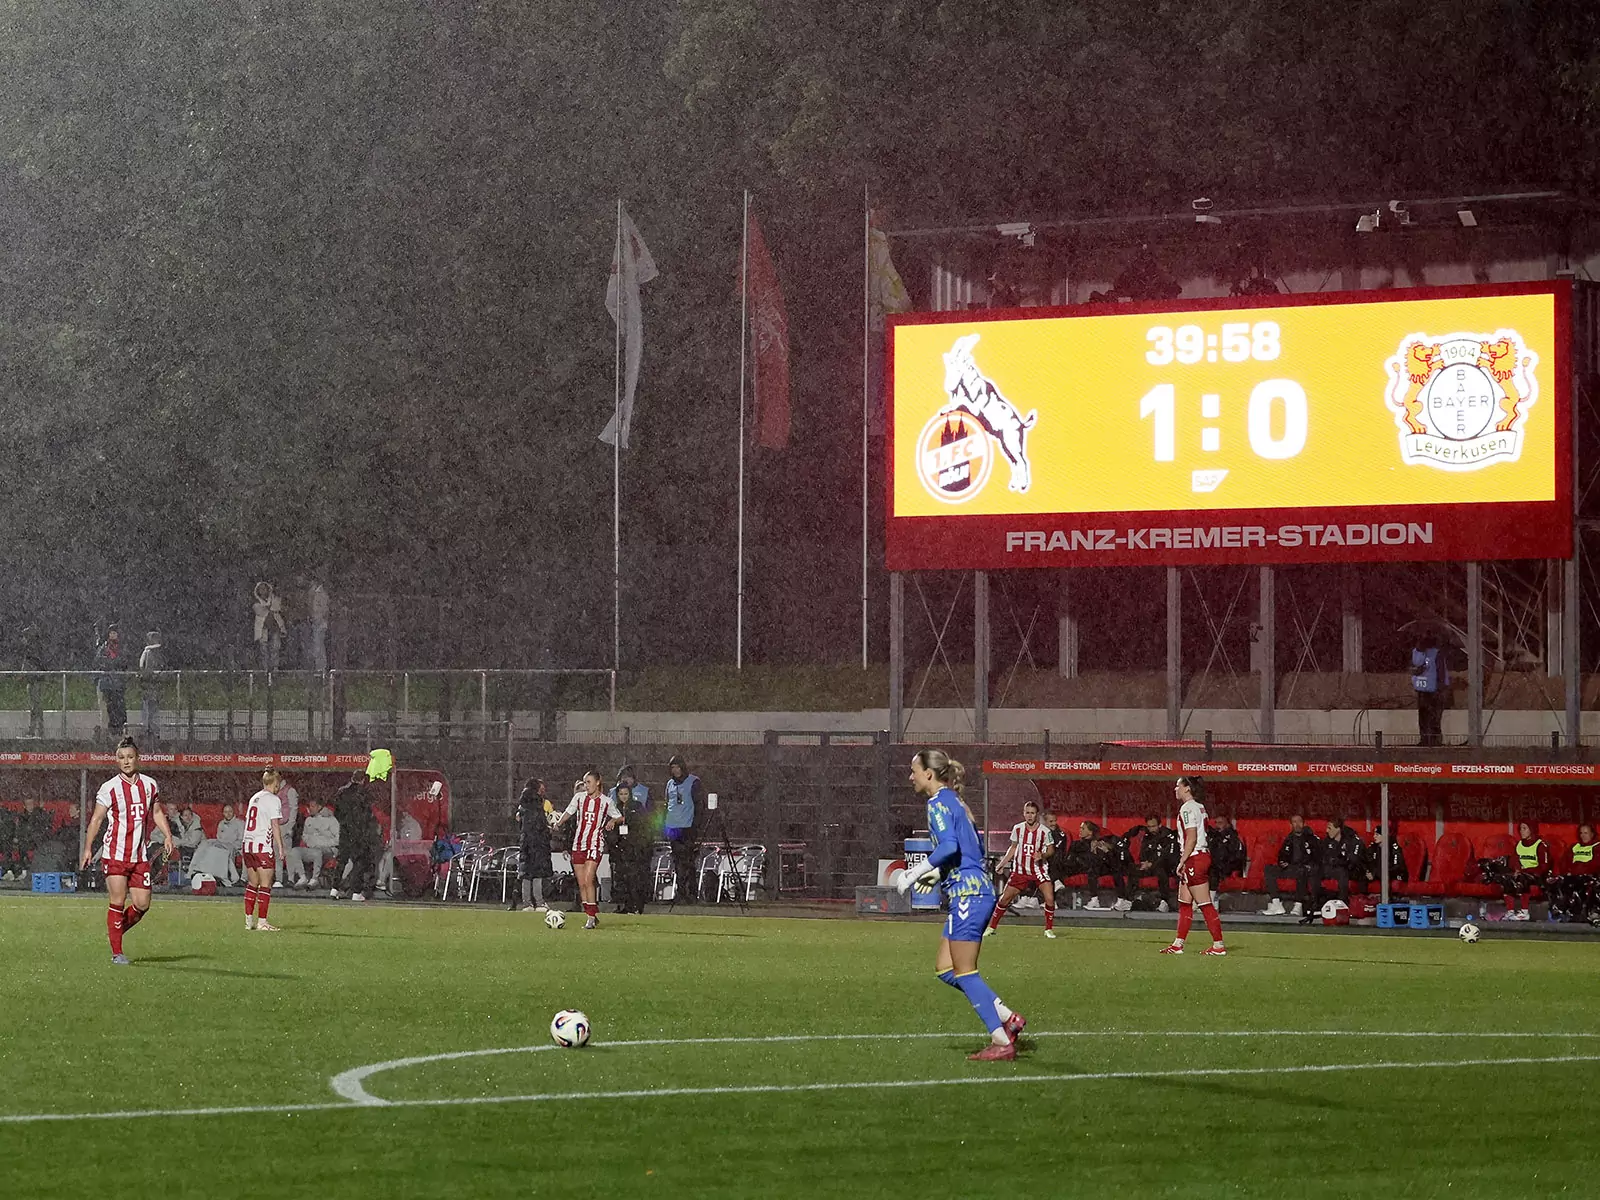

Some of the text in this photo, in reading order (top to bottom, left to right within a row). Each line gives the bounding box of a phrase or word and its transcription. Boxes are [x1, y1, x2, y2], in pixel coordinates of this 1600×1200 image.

[1145, 321, 1281, 366] 39:58
[1444, 345, 1477, 360] 1904
[1433, 395, 1490, 409] BAYER
[1415, 438, 1507, 460] Leverkusen
[1006, 522, 1433, 552] FRANZ-KREMER-STADION
[90, 753, 118, 762] RheinEner
[238, 755, 273, 765] RheinEnergie
[281, 755, 328, 763] EFFZEH-STROM
[334, 755, 352, 763] JETZT
[992, 761, 1594, 775] RheinEnergie EFFZEH-STROM JETZT WECHSELN! RheinEnergie EFFZEH-STROM JETZT WECHSELN! RheinEnergie EFFZEH-STROM JETZT WECHSELN!
[130, 802, 145, 821] T
[247, 805, 258, 832] 8
[586, 849, 597, 860] 14
[143, 871, 151, 887] 3
